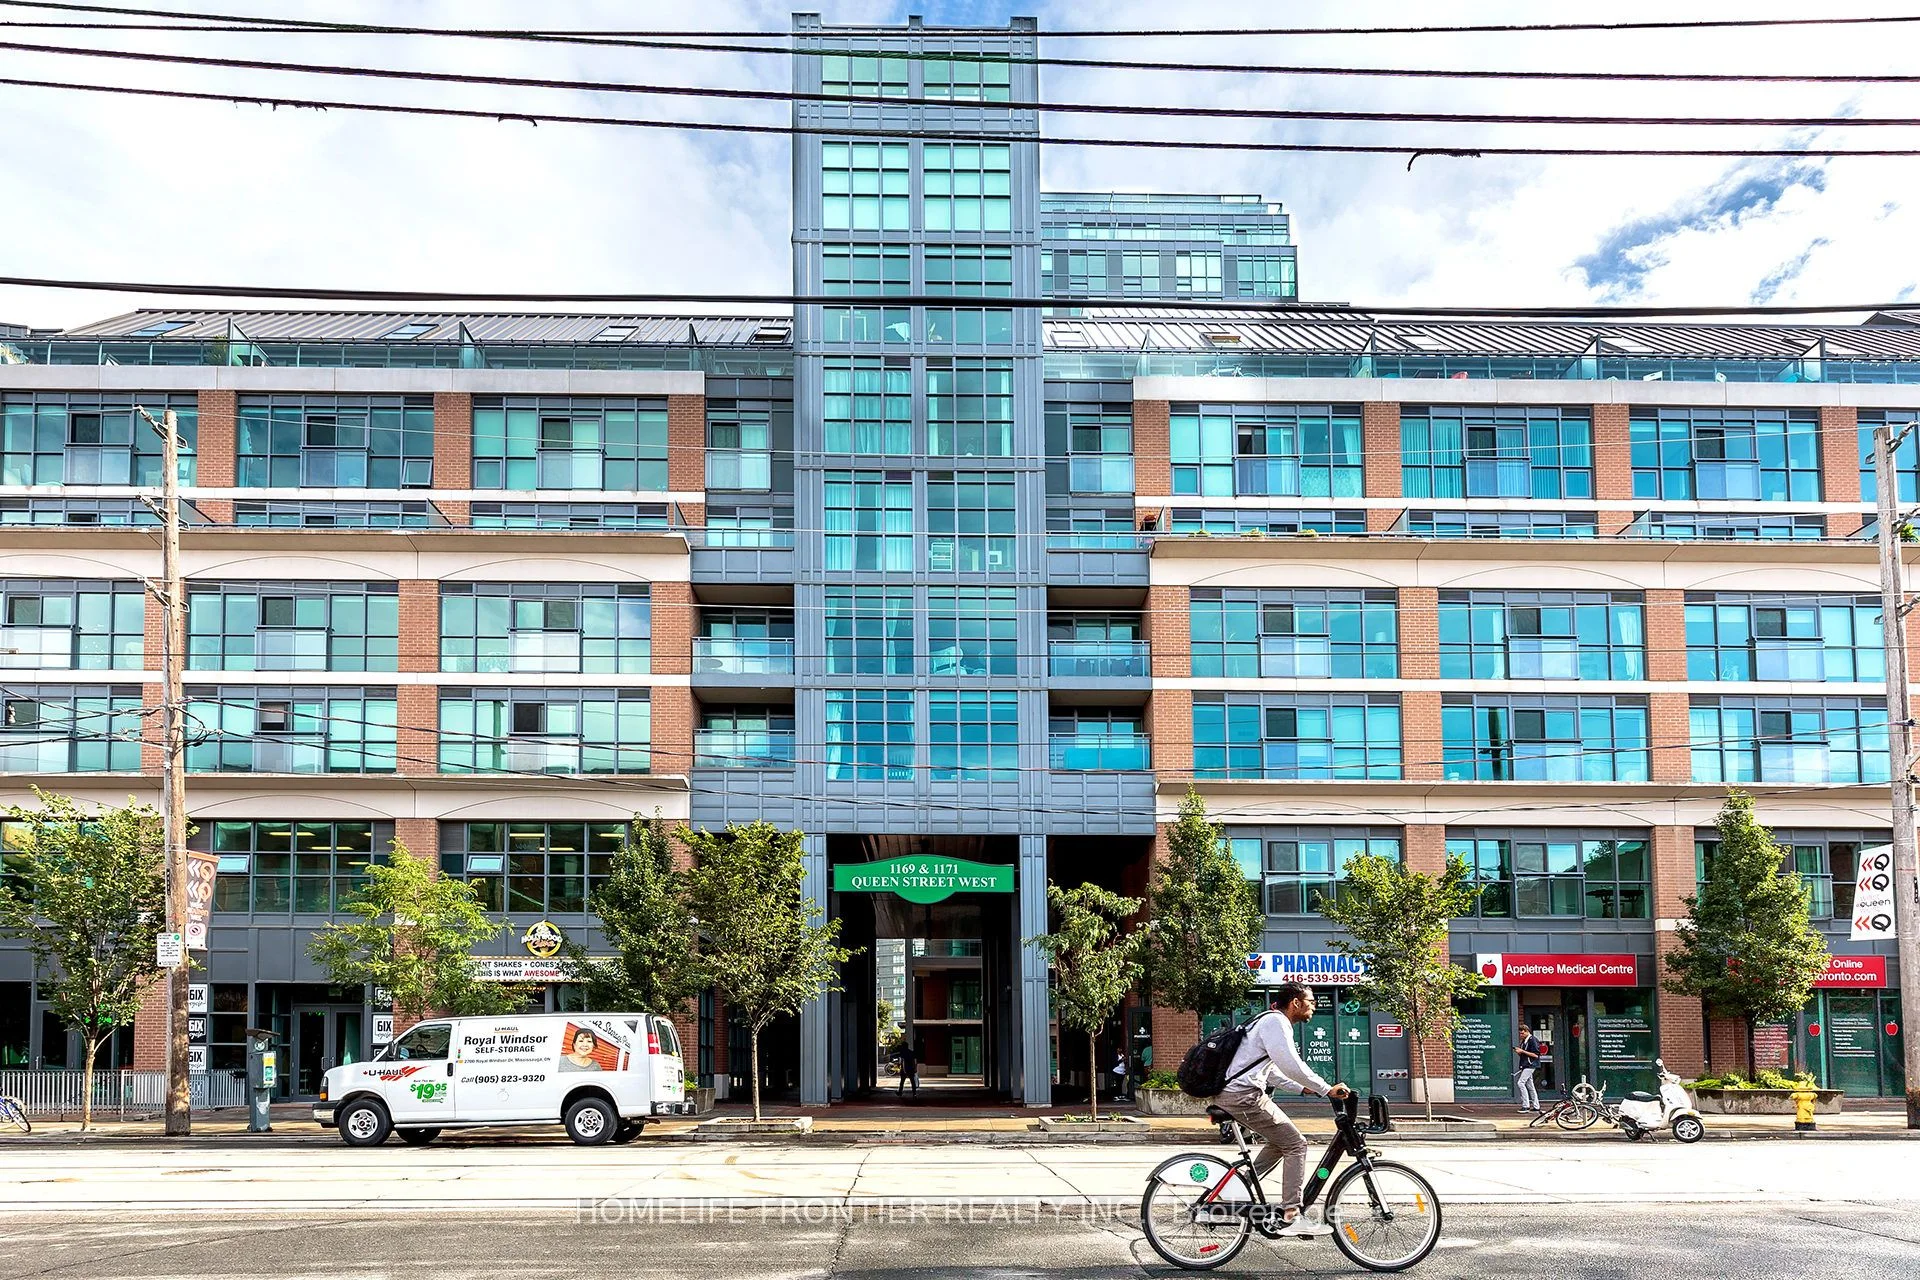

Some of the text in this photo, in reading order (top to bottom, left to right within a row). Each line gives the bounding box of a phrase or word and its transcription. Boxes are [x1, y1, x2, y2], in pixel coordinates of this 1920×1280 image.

[890, 864, 959, 874] 1169 & 1171
[851, 877, 997, 889] QUEEN STREET WEST
[1832, 959, 1863, 969] Online
[1505, 963, 1634, 976] Appletree Medical Centre
[1282, 974, 1360, 983] 416-539-9555
[464, 1035, 548, 1047] Royal Windsor
[475, 1046, 535, 1054] SELF-STORAGE
[474, 1074, 499, 1084] (905)
[500, 1074, 546, 1083] 823-9320
